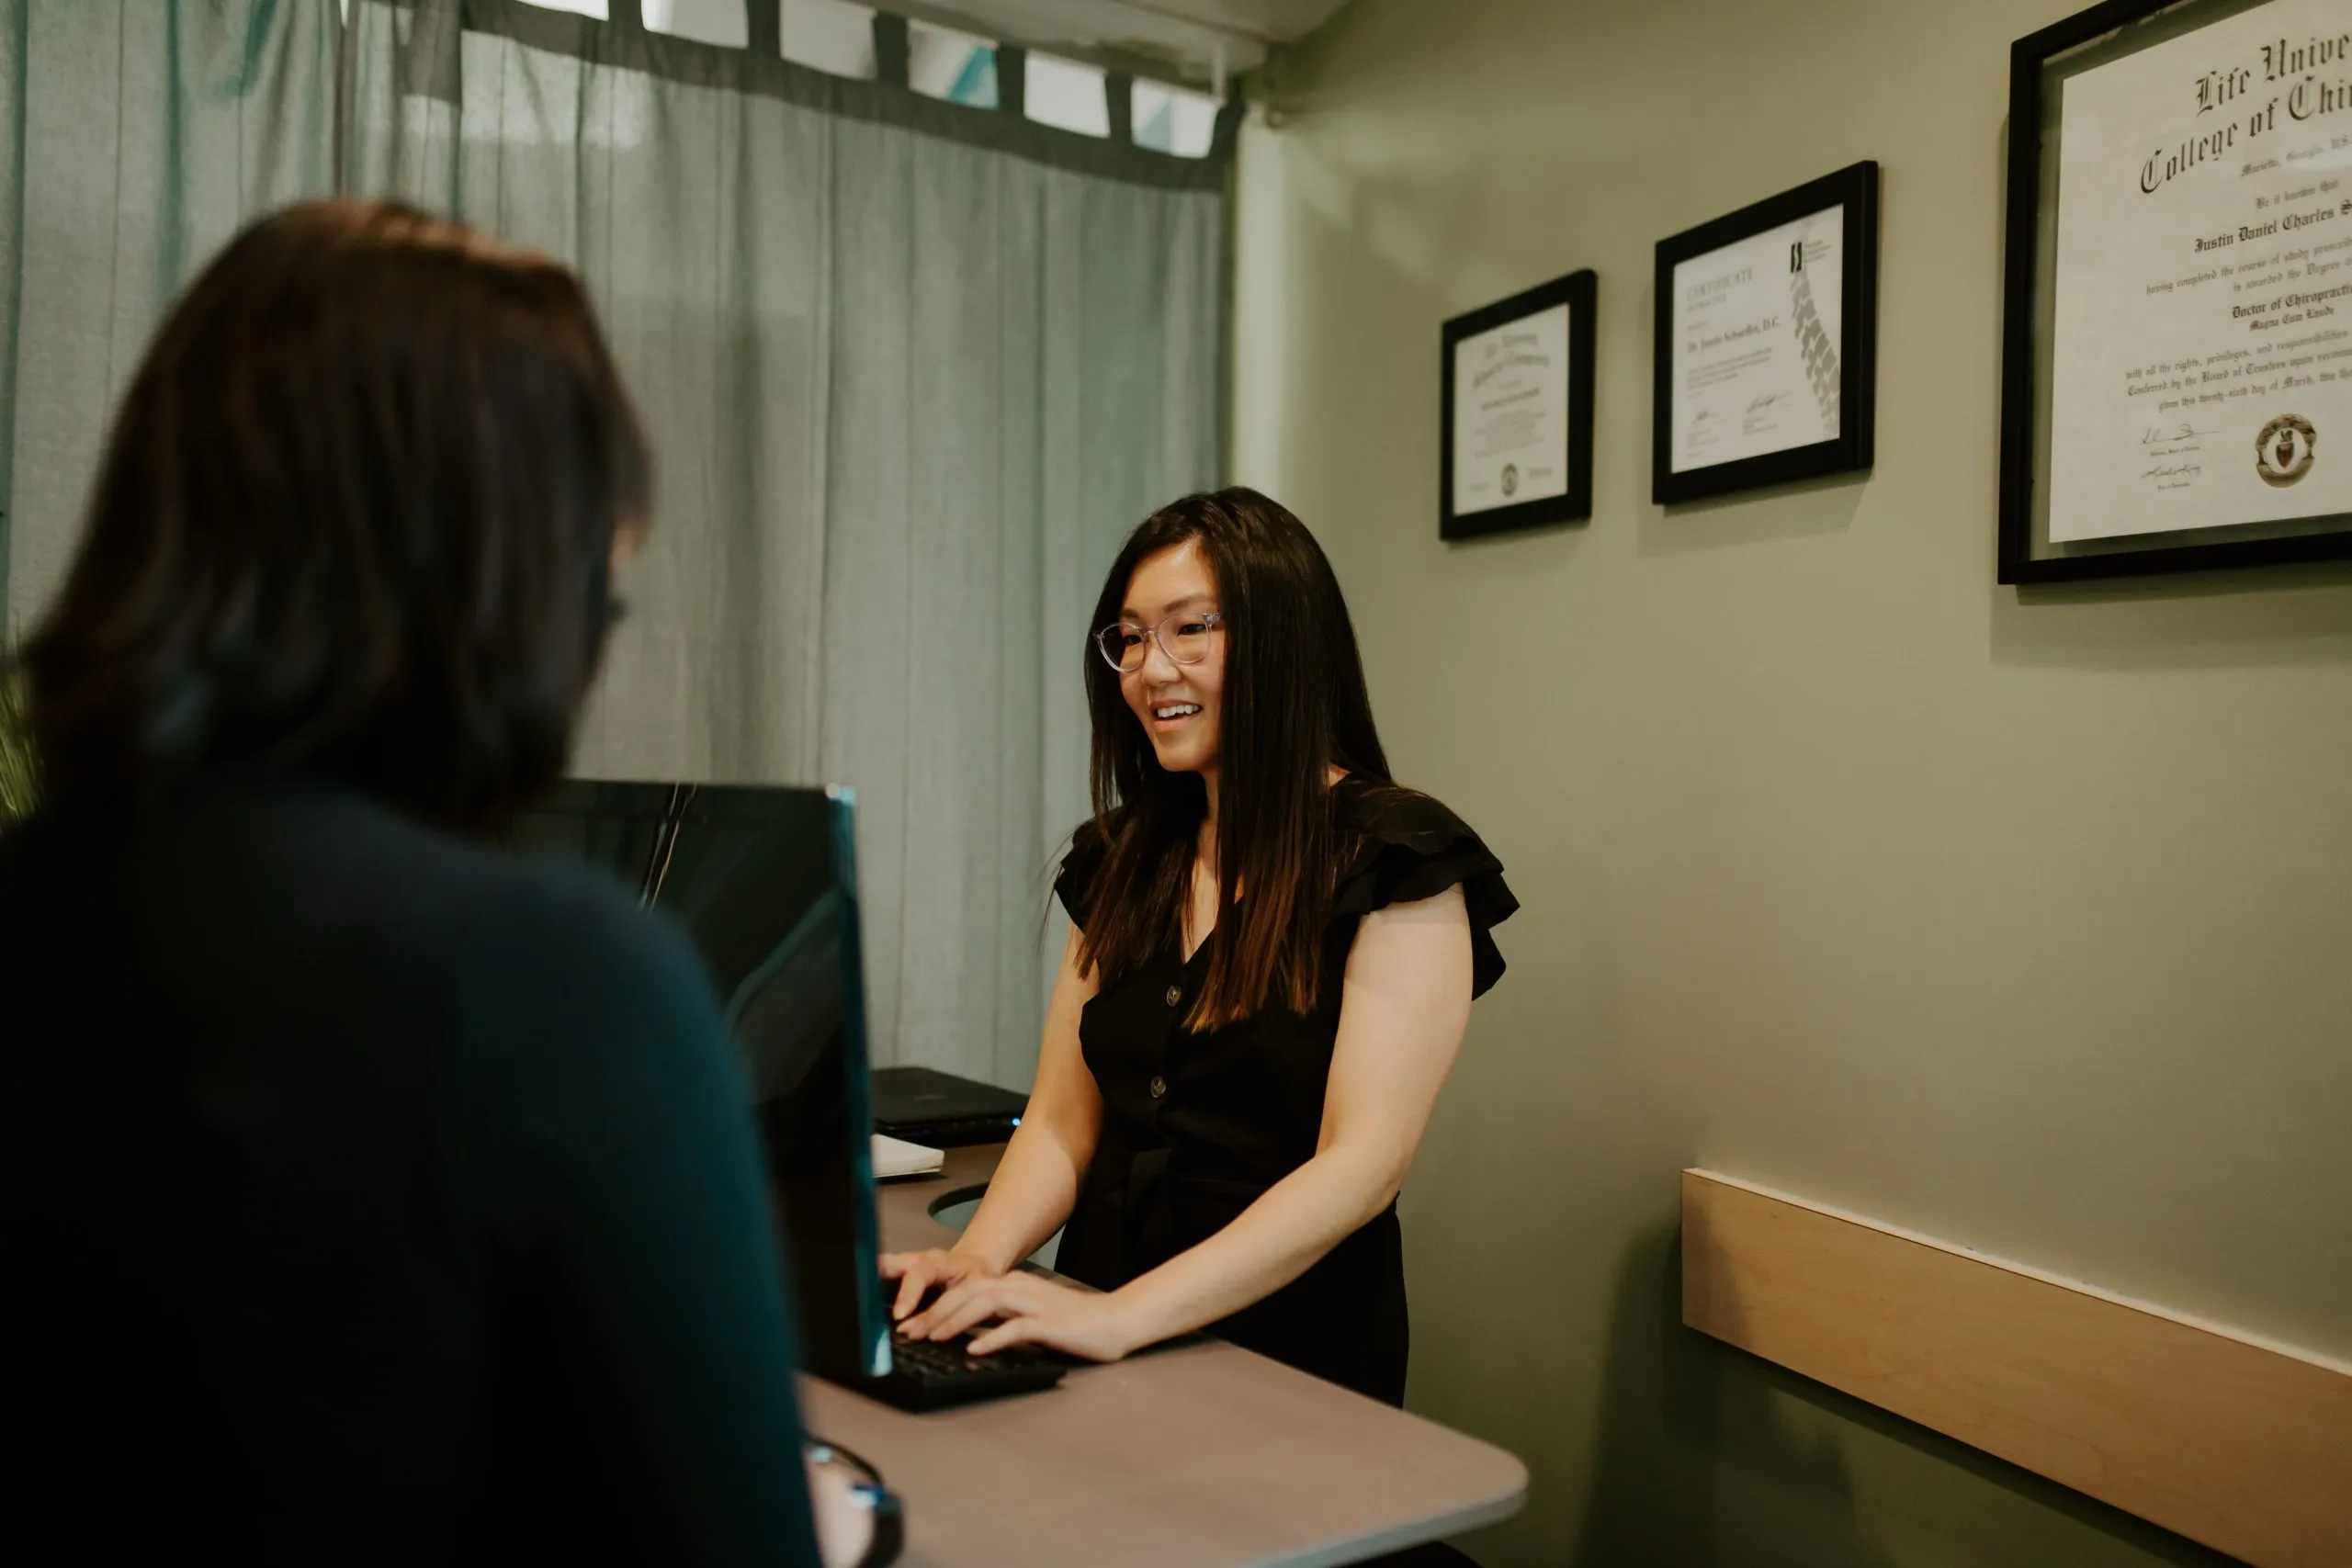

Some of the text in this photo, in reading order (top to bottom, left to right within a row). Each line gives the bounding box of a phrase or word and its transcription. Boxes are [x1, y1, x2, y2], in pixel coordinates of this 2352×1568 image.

[2196, 67, 2251, 117] Life
[2141, 122, 2238, 194] College
[2249, 97, 2279, 138] of
[2194, 234, 2233, 254] Justin
[2238, 220, 2278, 242] Daniel
[2282, 208, 2335, 231] Charles
[2177, 269, 2217, 288] completed
[2222, 265, 2234, 276] the
[2232, 284, 2352, 319] Doctor of Chiropracti
[2159, 362, 2171, 374] the
[2185, 376, 2198, 388] the
[2201, 369, 2230, 383] Board
[2233, 366, 2243, 378] of
